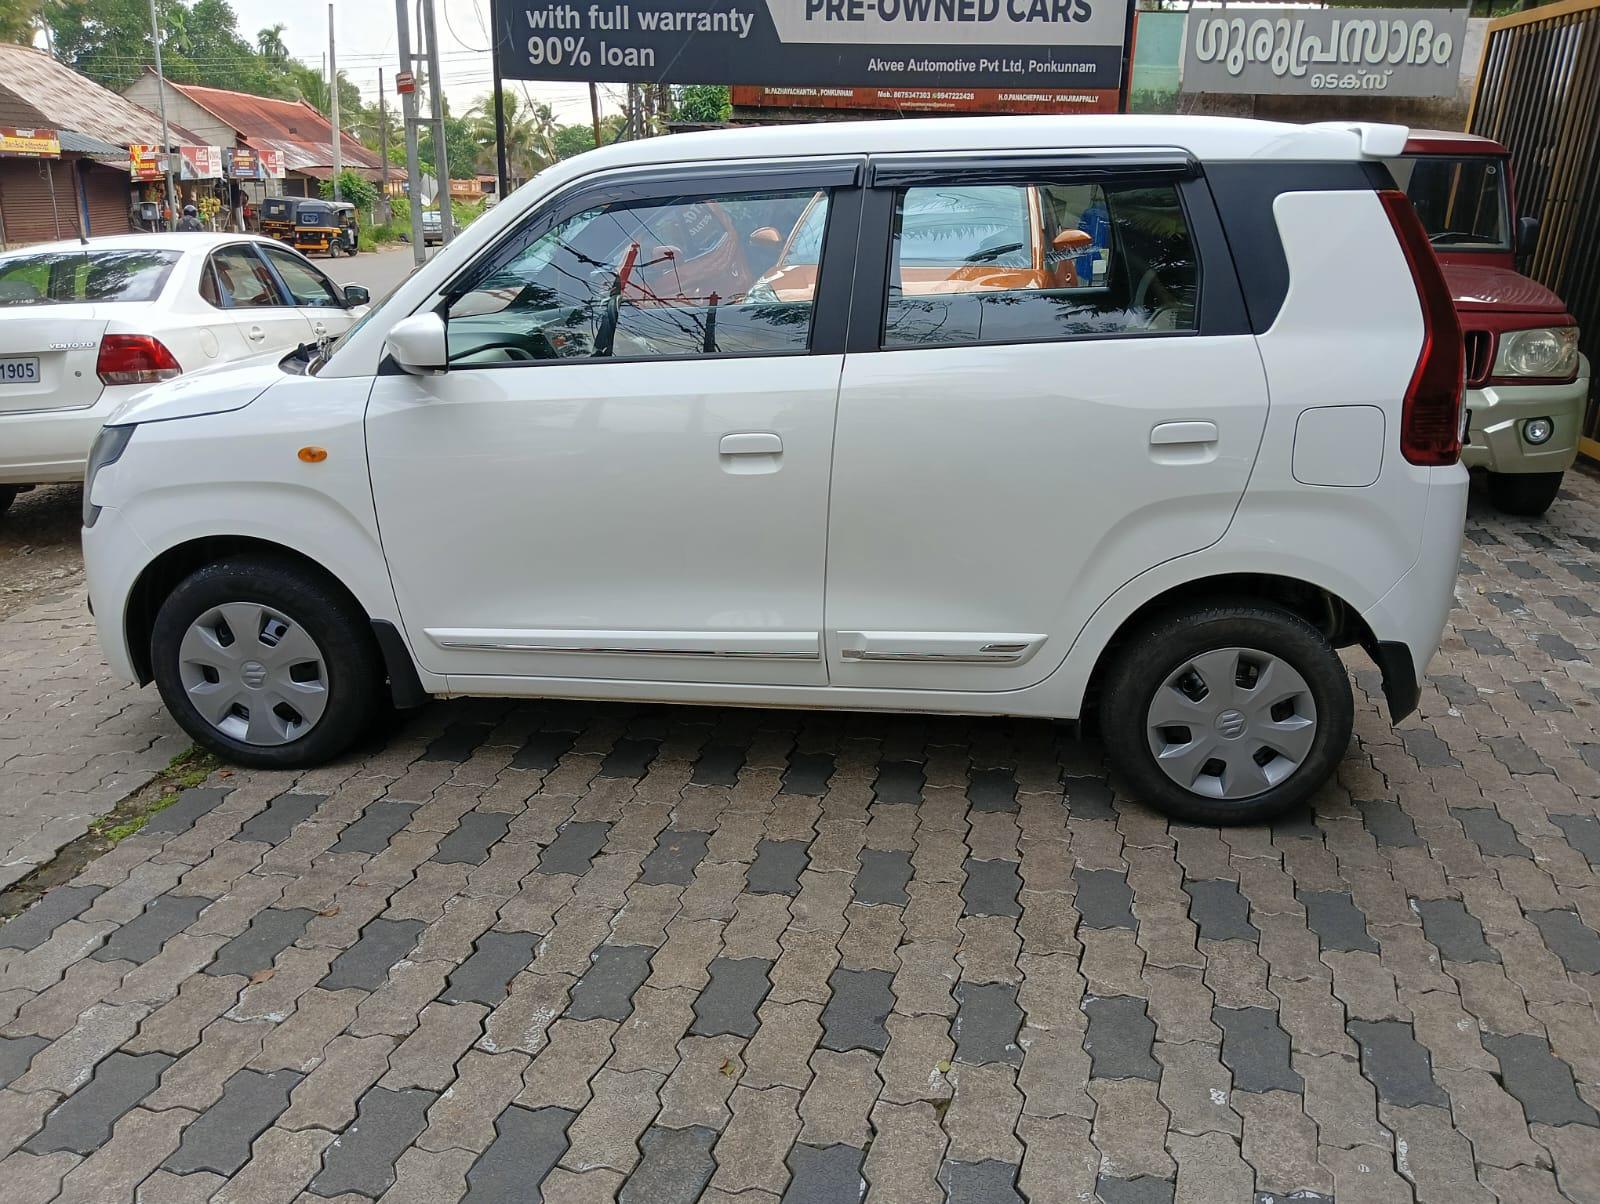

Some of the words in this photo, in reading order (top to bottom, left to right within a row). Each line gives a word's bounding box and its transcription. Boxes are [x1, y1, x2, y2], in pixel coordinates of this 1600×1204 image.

[526, 5, 580, 29] with
[588, 5, 629, 30] full
[637, 8, 755, 39] warranty
[805, 0, 999, 21] PRE-OWNED
[1006, 0, 1092, 22] CARS
[527, 36, 592, 67] 90%
[600, 41, 655, 67] loan
[1195, 17, 1453, 76] ഗുരുപ്രസാദം
[867, 58, 904, 72] Akvee
[907, 58, 976, 72] Automotive
[979, 59, 999, 72] Pvt
[1002, 59, 1025, 75] Ltd,
[1028, 60, 1097, 73] Ponkunnam
[0, 362, 34, 379] 1905
